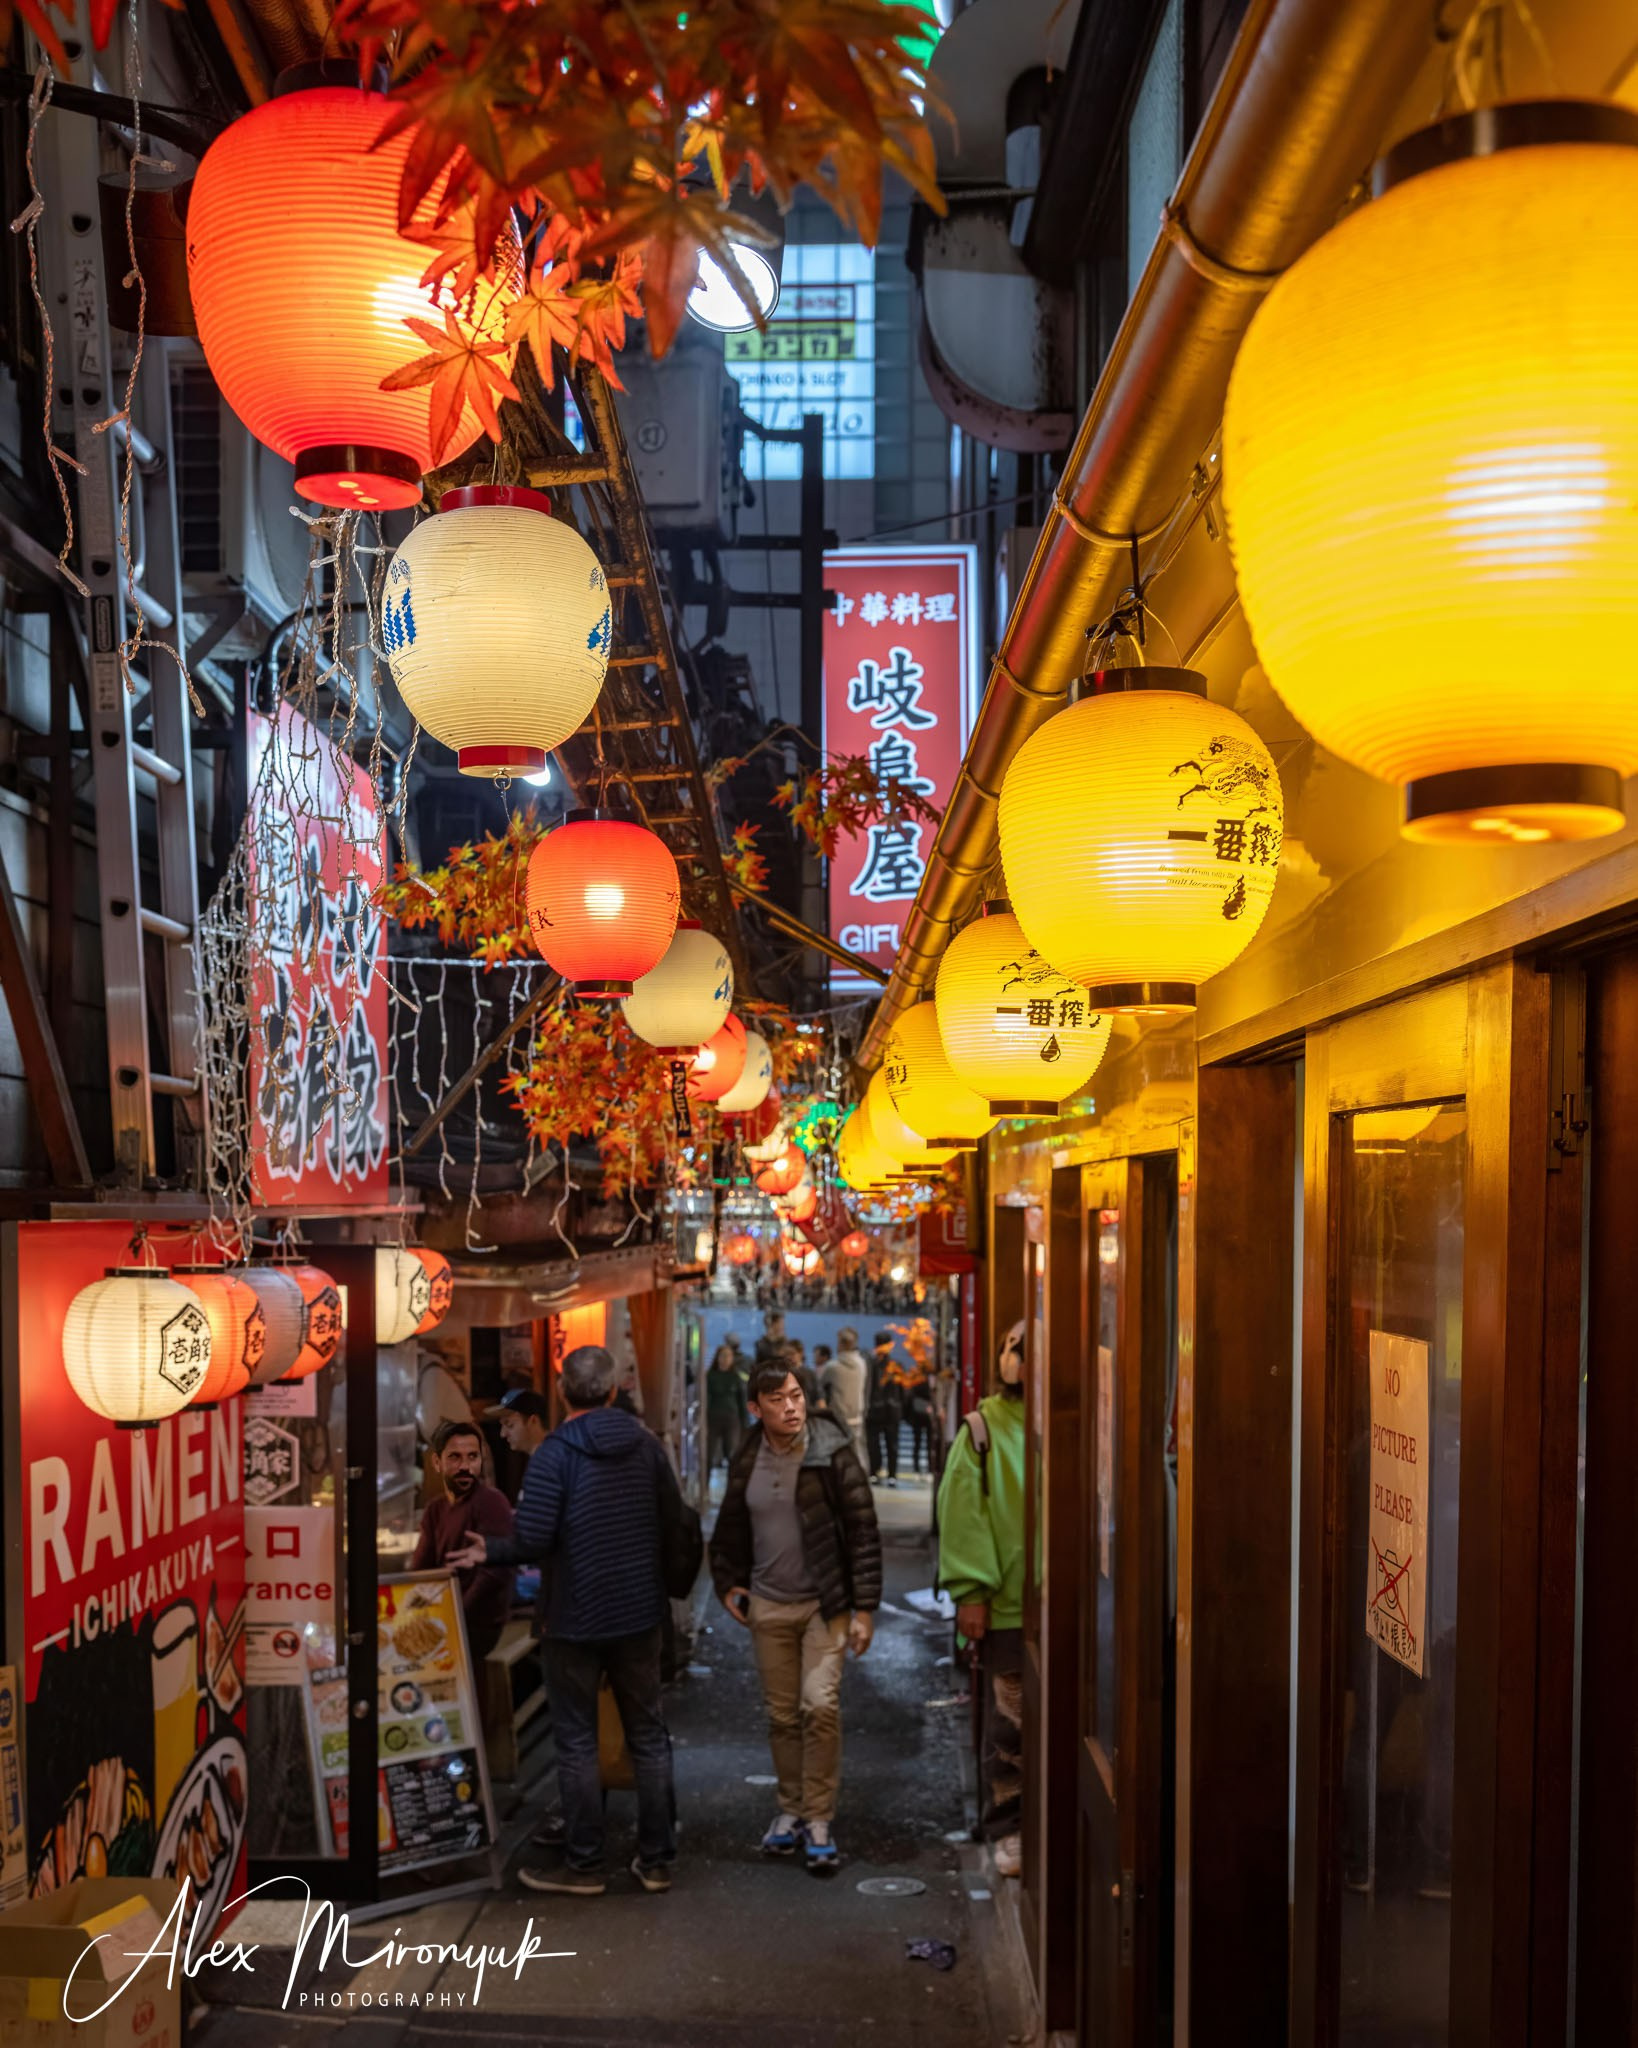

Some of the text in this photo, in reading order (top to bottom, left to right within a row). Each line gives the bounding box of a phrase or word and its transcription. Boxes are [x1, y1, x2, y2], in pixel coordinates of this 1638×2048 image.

[830, 592, 959, 627] 中華料理
[847, 646, 938, 902] 岐阜屋
[1385, 1368, 1400, 1397] NO
[1373, 1423, 1417, 1465] PICTURE
[30, 1398, 240, 1598] RAMEN
[1375, 1483, 1413, 1524] PLEASE
[73, 1535, 214, 1648] ICHIKAKUYA
